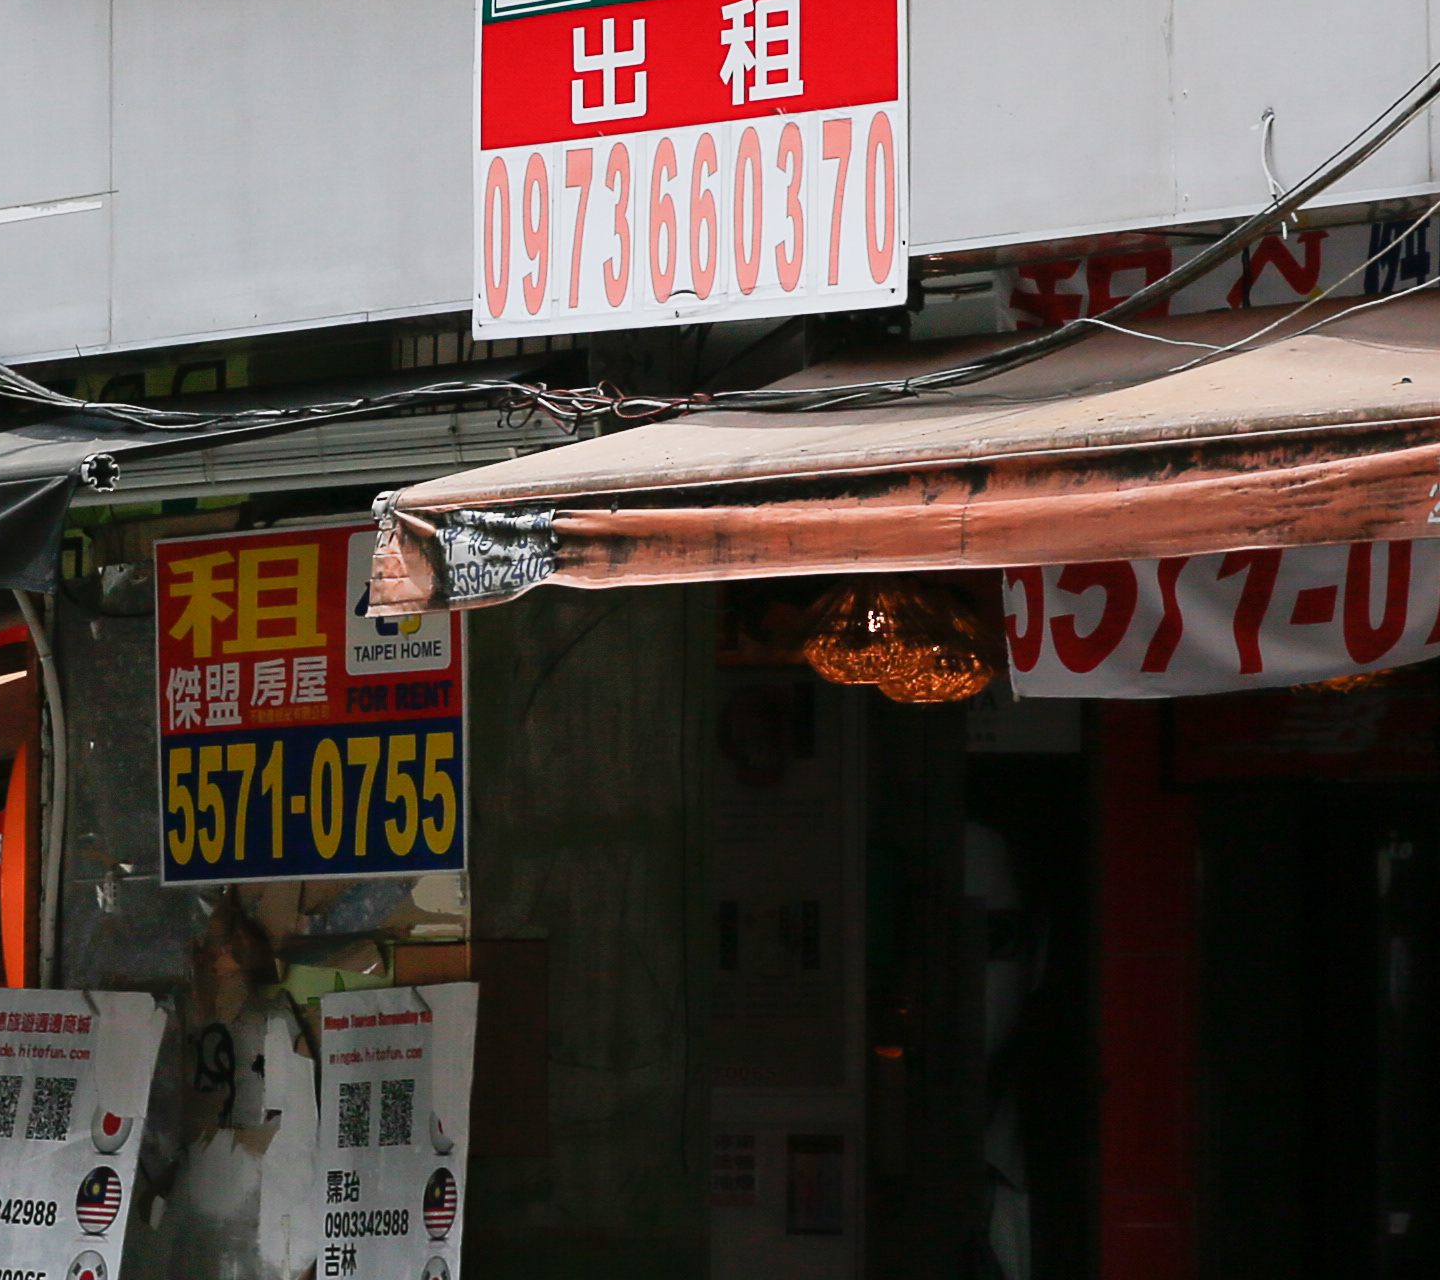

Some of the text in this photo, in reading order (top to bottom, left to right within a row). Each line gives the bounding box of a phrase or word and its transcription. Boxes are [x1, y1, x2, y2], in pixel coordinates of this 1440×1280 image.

[484, 111, 901, 319] 0973660370
[168, 543, 328, 658] 租
[354, 640, 442, 662] TAIPEI HOME
[346, 681, 453, 713] FOR RENT
[167, 732, 456, 865] 5571-0755
[325, 1209, 409, 1238] 0903342988
[324, 1242, 357, 1277] 吉林
